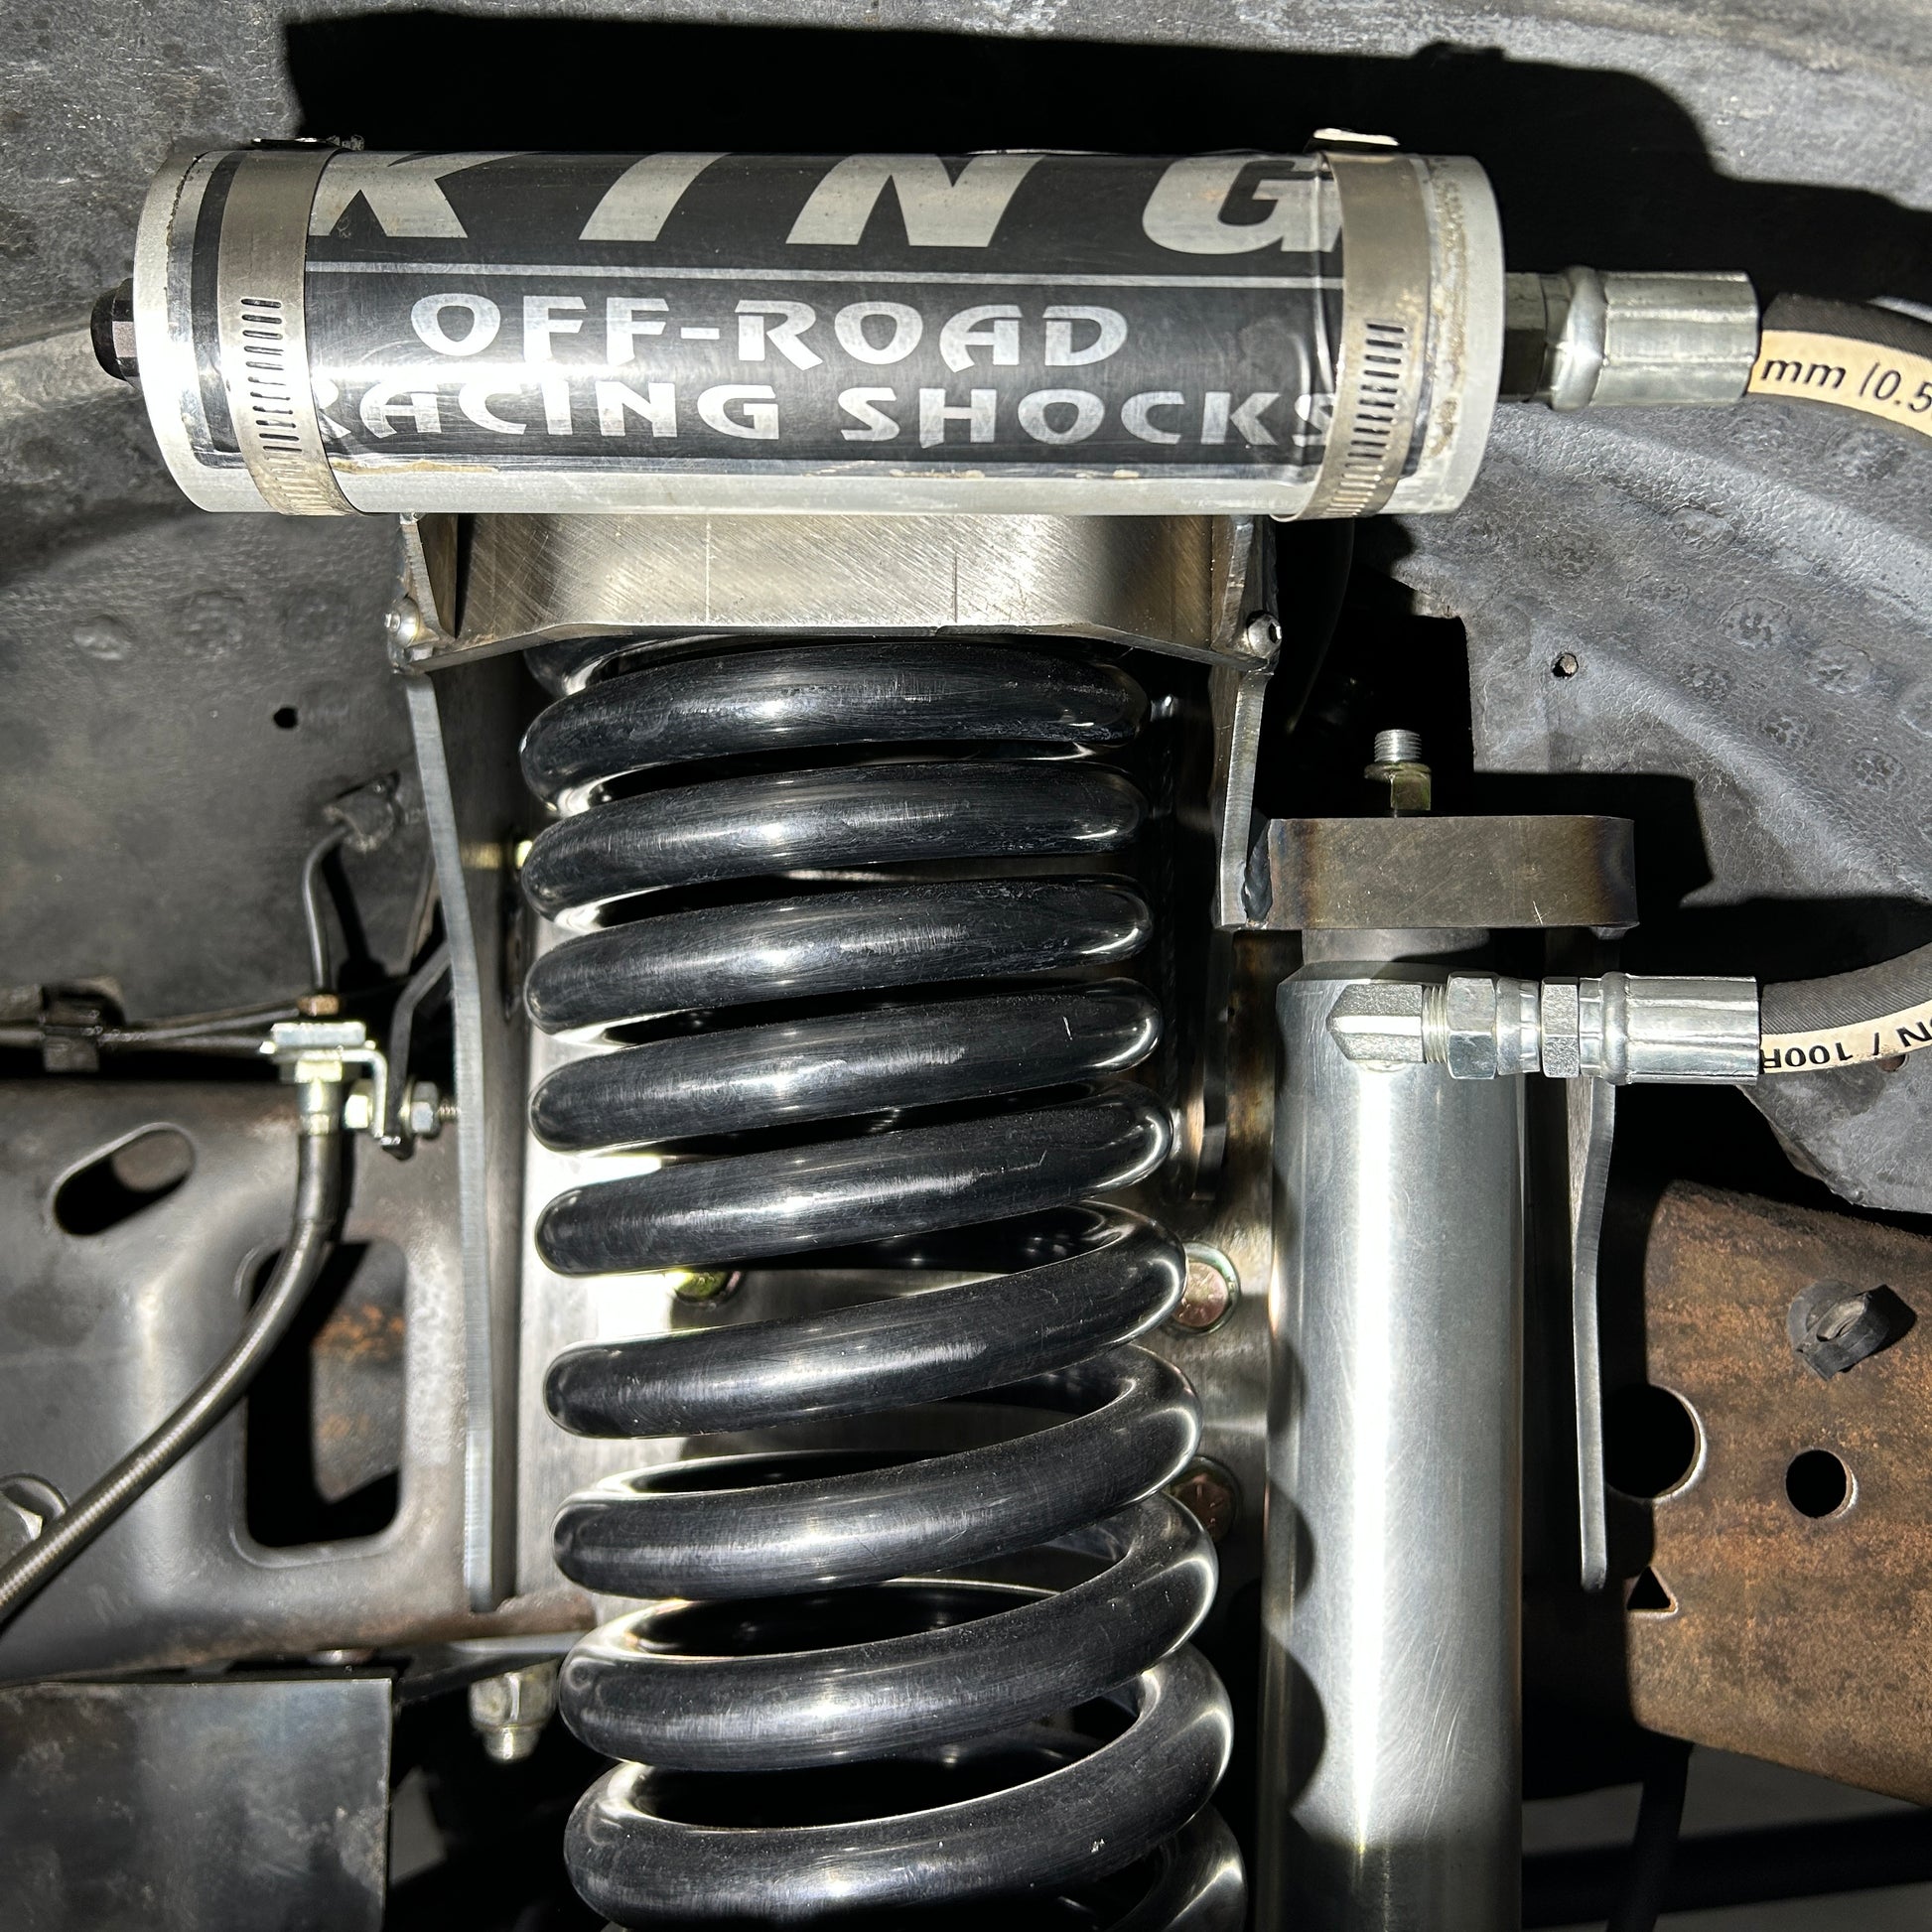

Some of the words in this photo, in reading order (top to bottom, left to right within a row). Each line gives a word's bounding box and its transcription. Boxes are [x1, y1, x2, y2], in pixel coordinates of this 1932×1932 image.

[411, 293, 1128, 372] OFF-ROAD
[1760, 358, 1847, 390] mm
[838, 386, 1335, 448] SHOCKS
